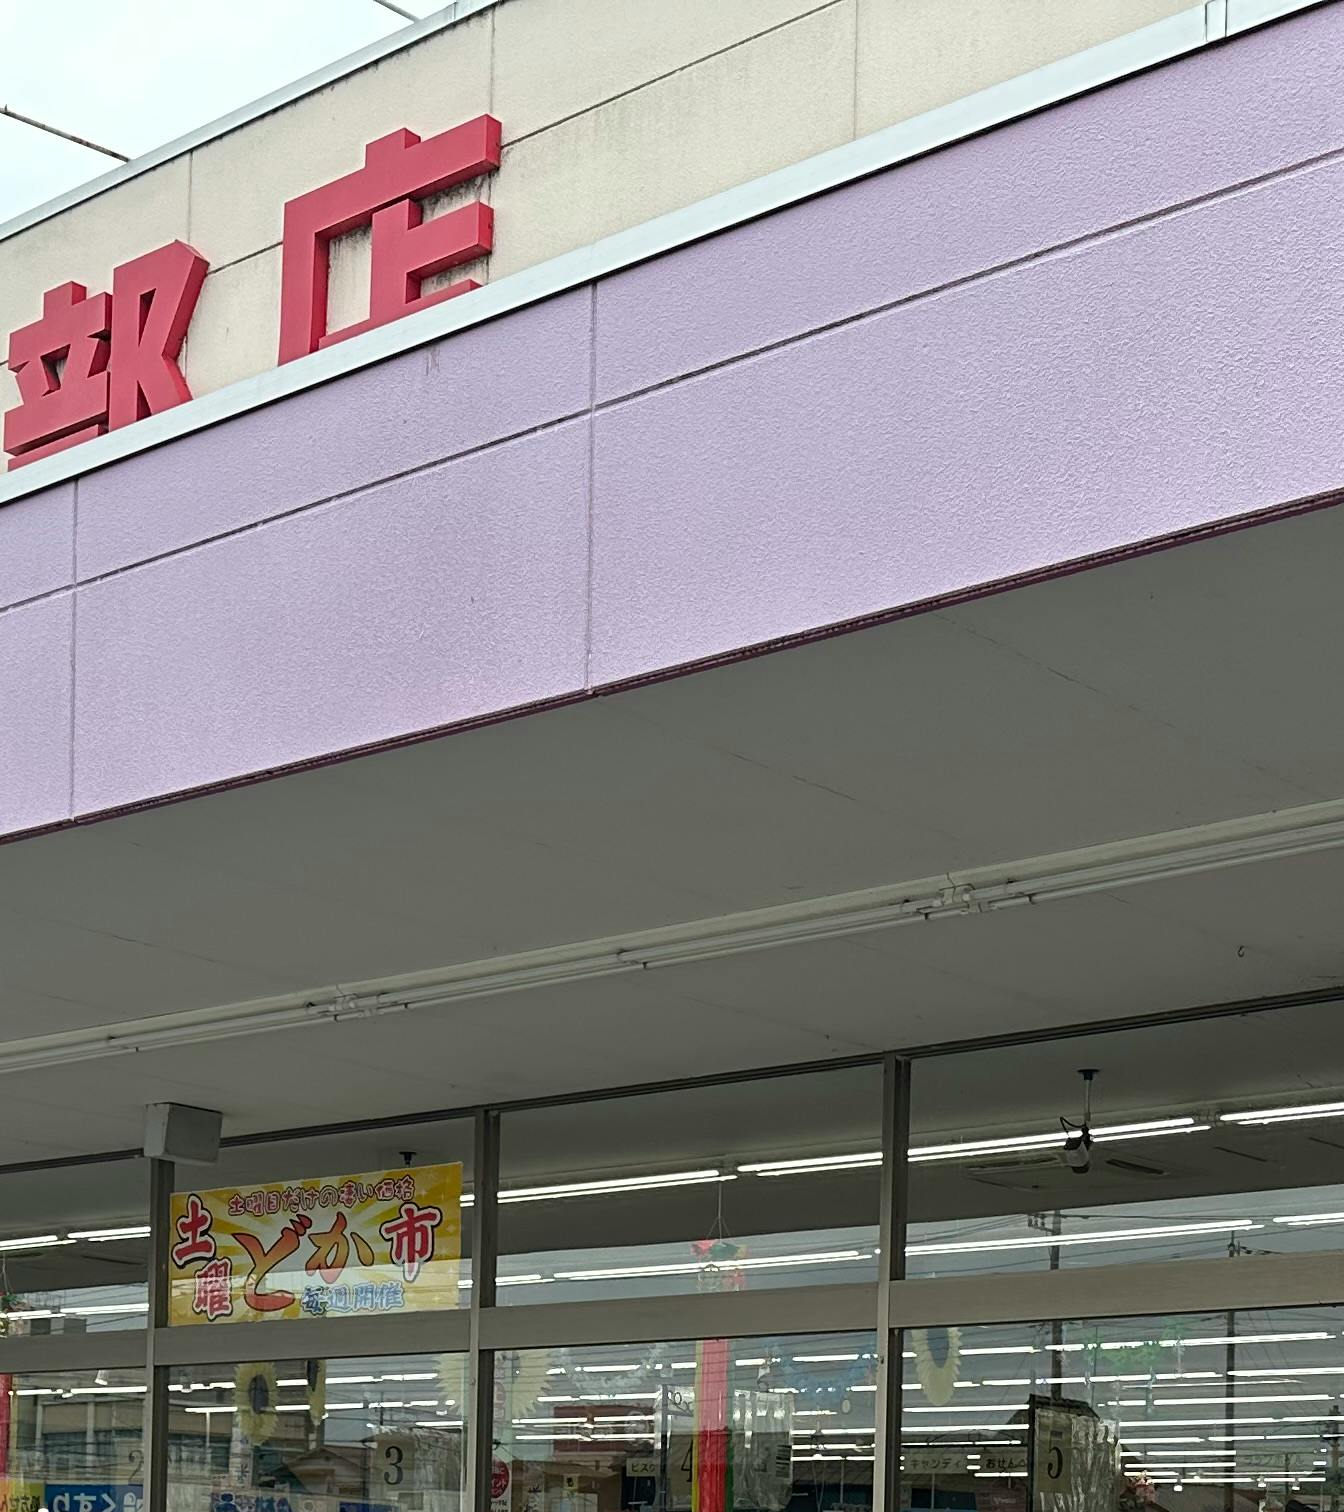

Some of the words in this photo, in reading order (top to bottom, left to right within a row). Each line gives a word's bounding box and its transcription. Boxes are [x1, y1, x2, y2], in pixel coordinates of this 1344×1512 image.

[301, 1280, 406, 1317] 毎週開催
[383, 1445, 404, 1486] 3
